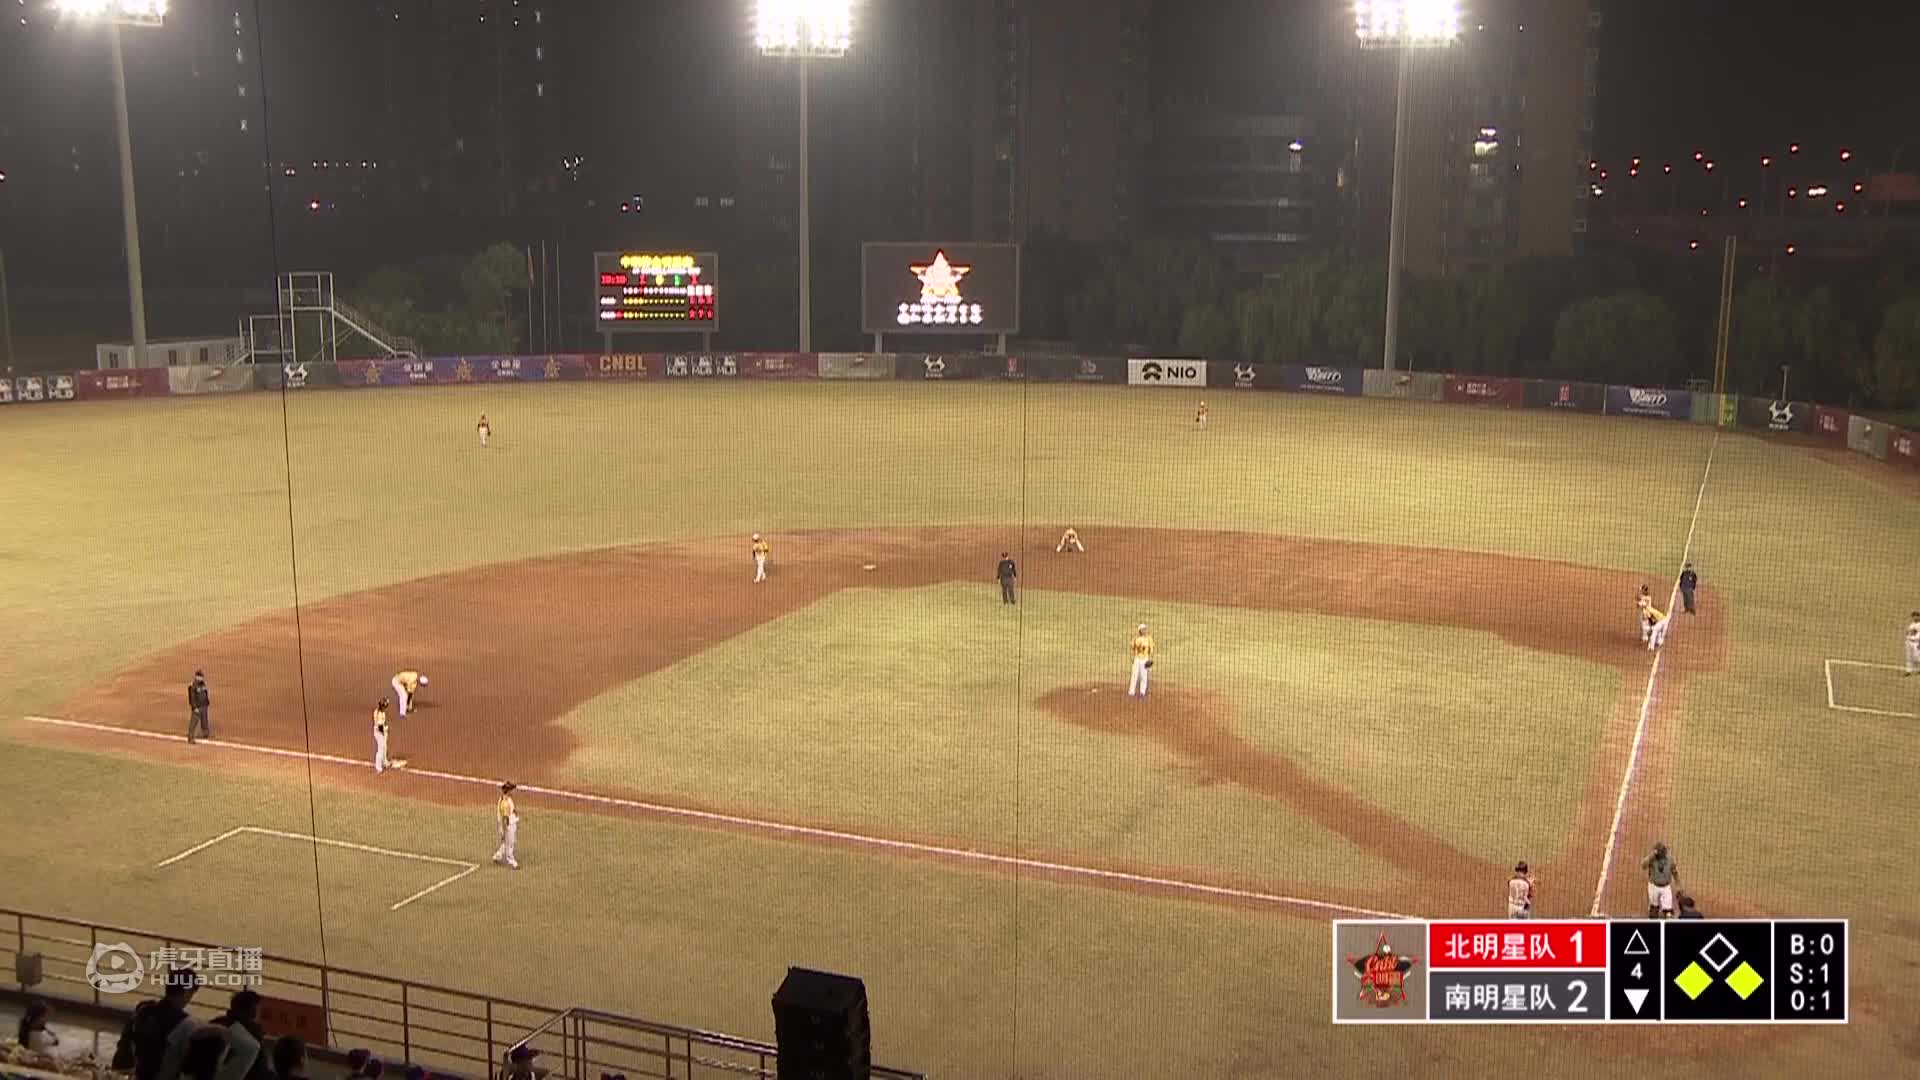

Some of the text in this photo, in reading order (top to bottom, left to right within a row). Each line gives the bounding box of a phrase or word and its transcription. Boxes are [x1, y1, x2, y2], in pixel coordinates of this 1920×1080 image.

[599, 356, 647, 370] CNBL
[1167, 366, 1197, 378] NIO
[48, 388, 74, 399] MLB
